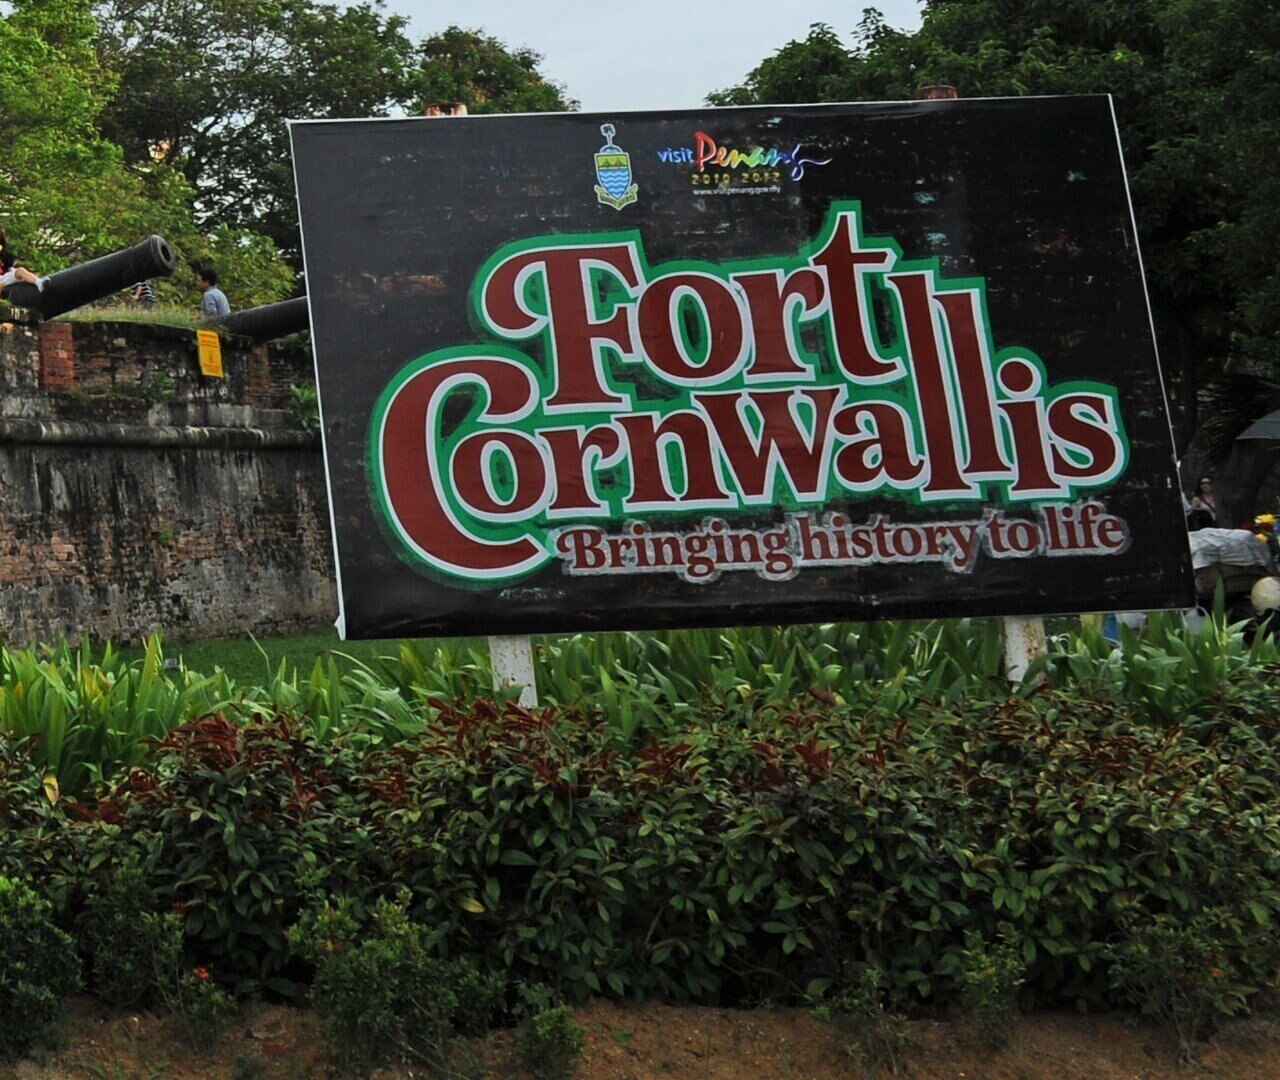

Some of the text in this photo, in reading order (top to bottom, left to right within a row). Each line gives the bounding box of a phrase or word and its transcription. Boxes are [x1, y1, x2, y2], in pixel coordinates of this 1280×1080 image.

[657, 131, 832, 181] visit Penang
[691, 173, 730, 185] 2010
[482, 210, 896, 414] Fort
[378, 270, 1123, 578] Cornwallis
[557, 504, 1124, 578] Bringing history to life
